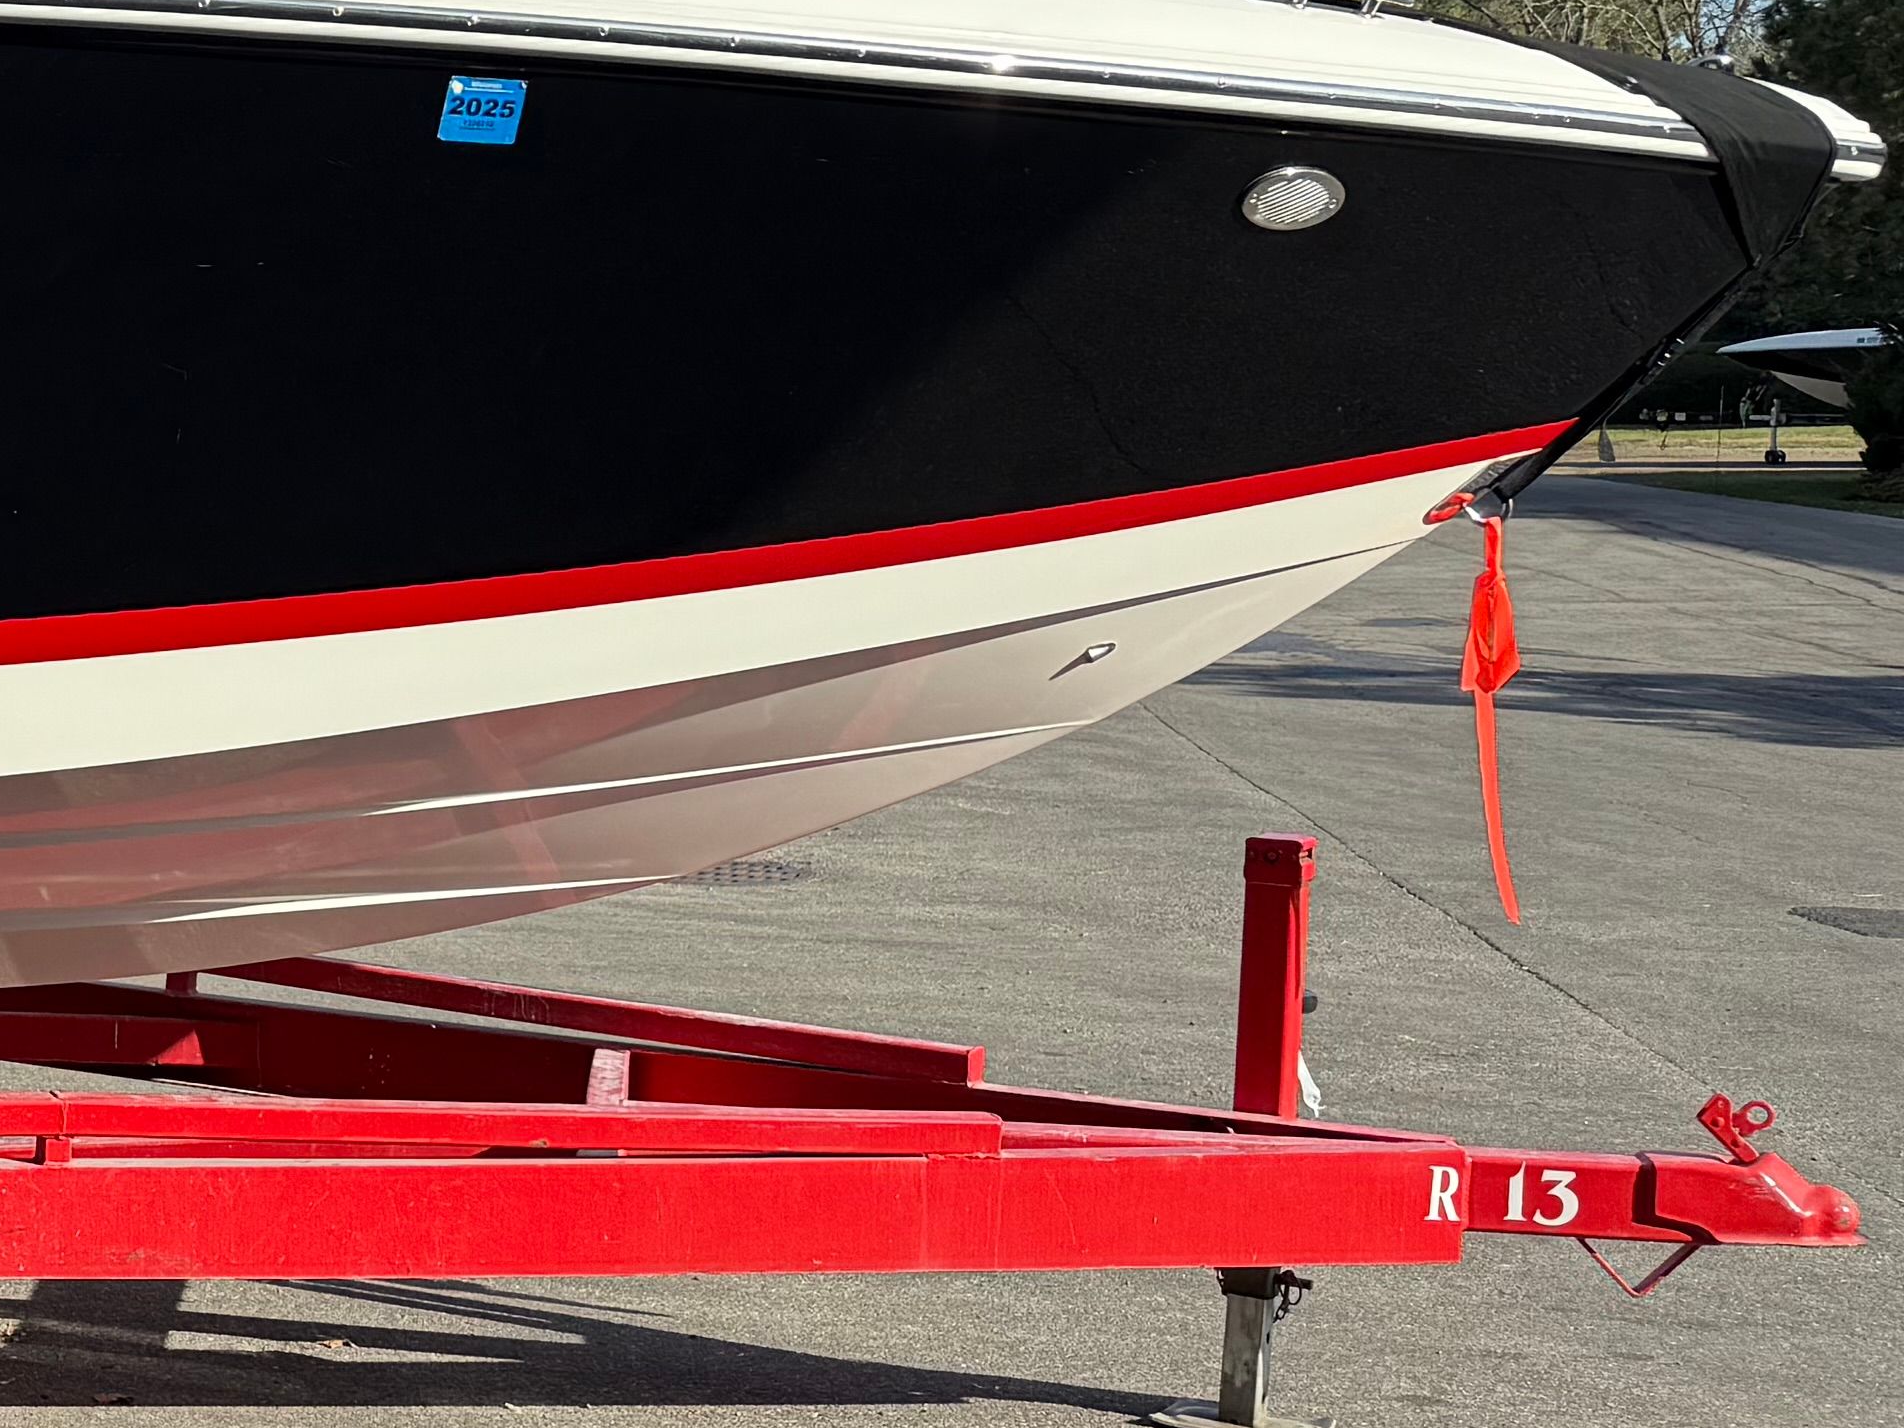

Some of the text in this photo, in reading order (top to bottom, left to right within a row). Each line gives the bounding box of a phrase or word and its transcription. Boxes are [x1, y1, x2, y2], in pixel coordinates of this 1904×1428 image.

[448, 97, 516, 119] 2025
[1424, 1160, 1579, 1227] R 13
